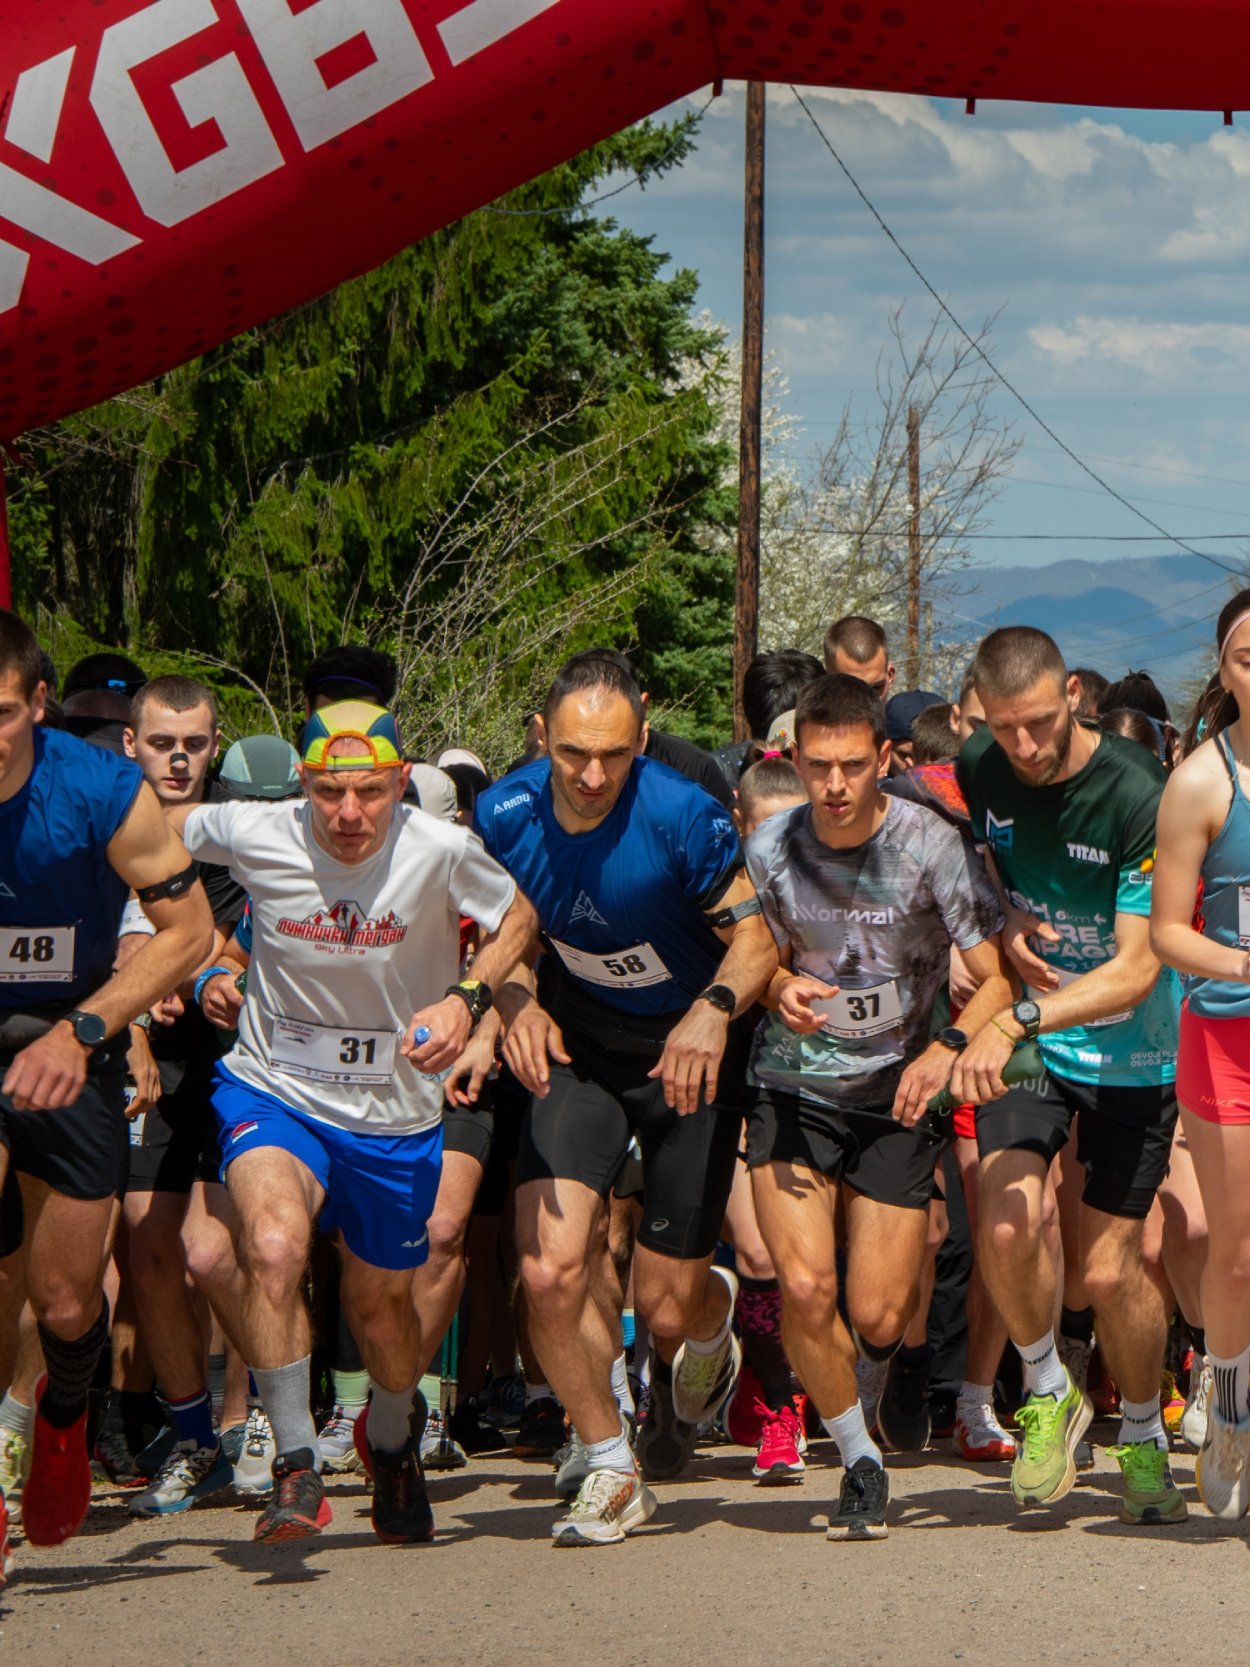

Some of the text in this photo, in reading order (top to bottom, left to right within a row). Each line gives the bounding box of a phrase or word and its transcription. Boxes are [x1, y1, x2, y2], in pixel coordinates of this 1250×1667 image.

[503, 793, 531, 811] ARDU
[1066, 842, 1110, 865] TITAN
[9, 935, 55, 963] 48
[314, 943, 366, 956] Sky Ultra
[601, 953, 648, 977] 58
[846, 993, 880, 1021] 37
[339, 1036, 376, 1065] 31
[1078, 1051, 1112, 1064] TITAN
